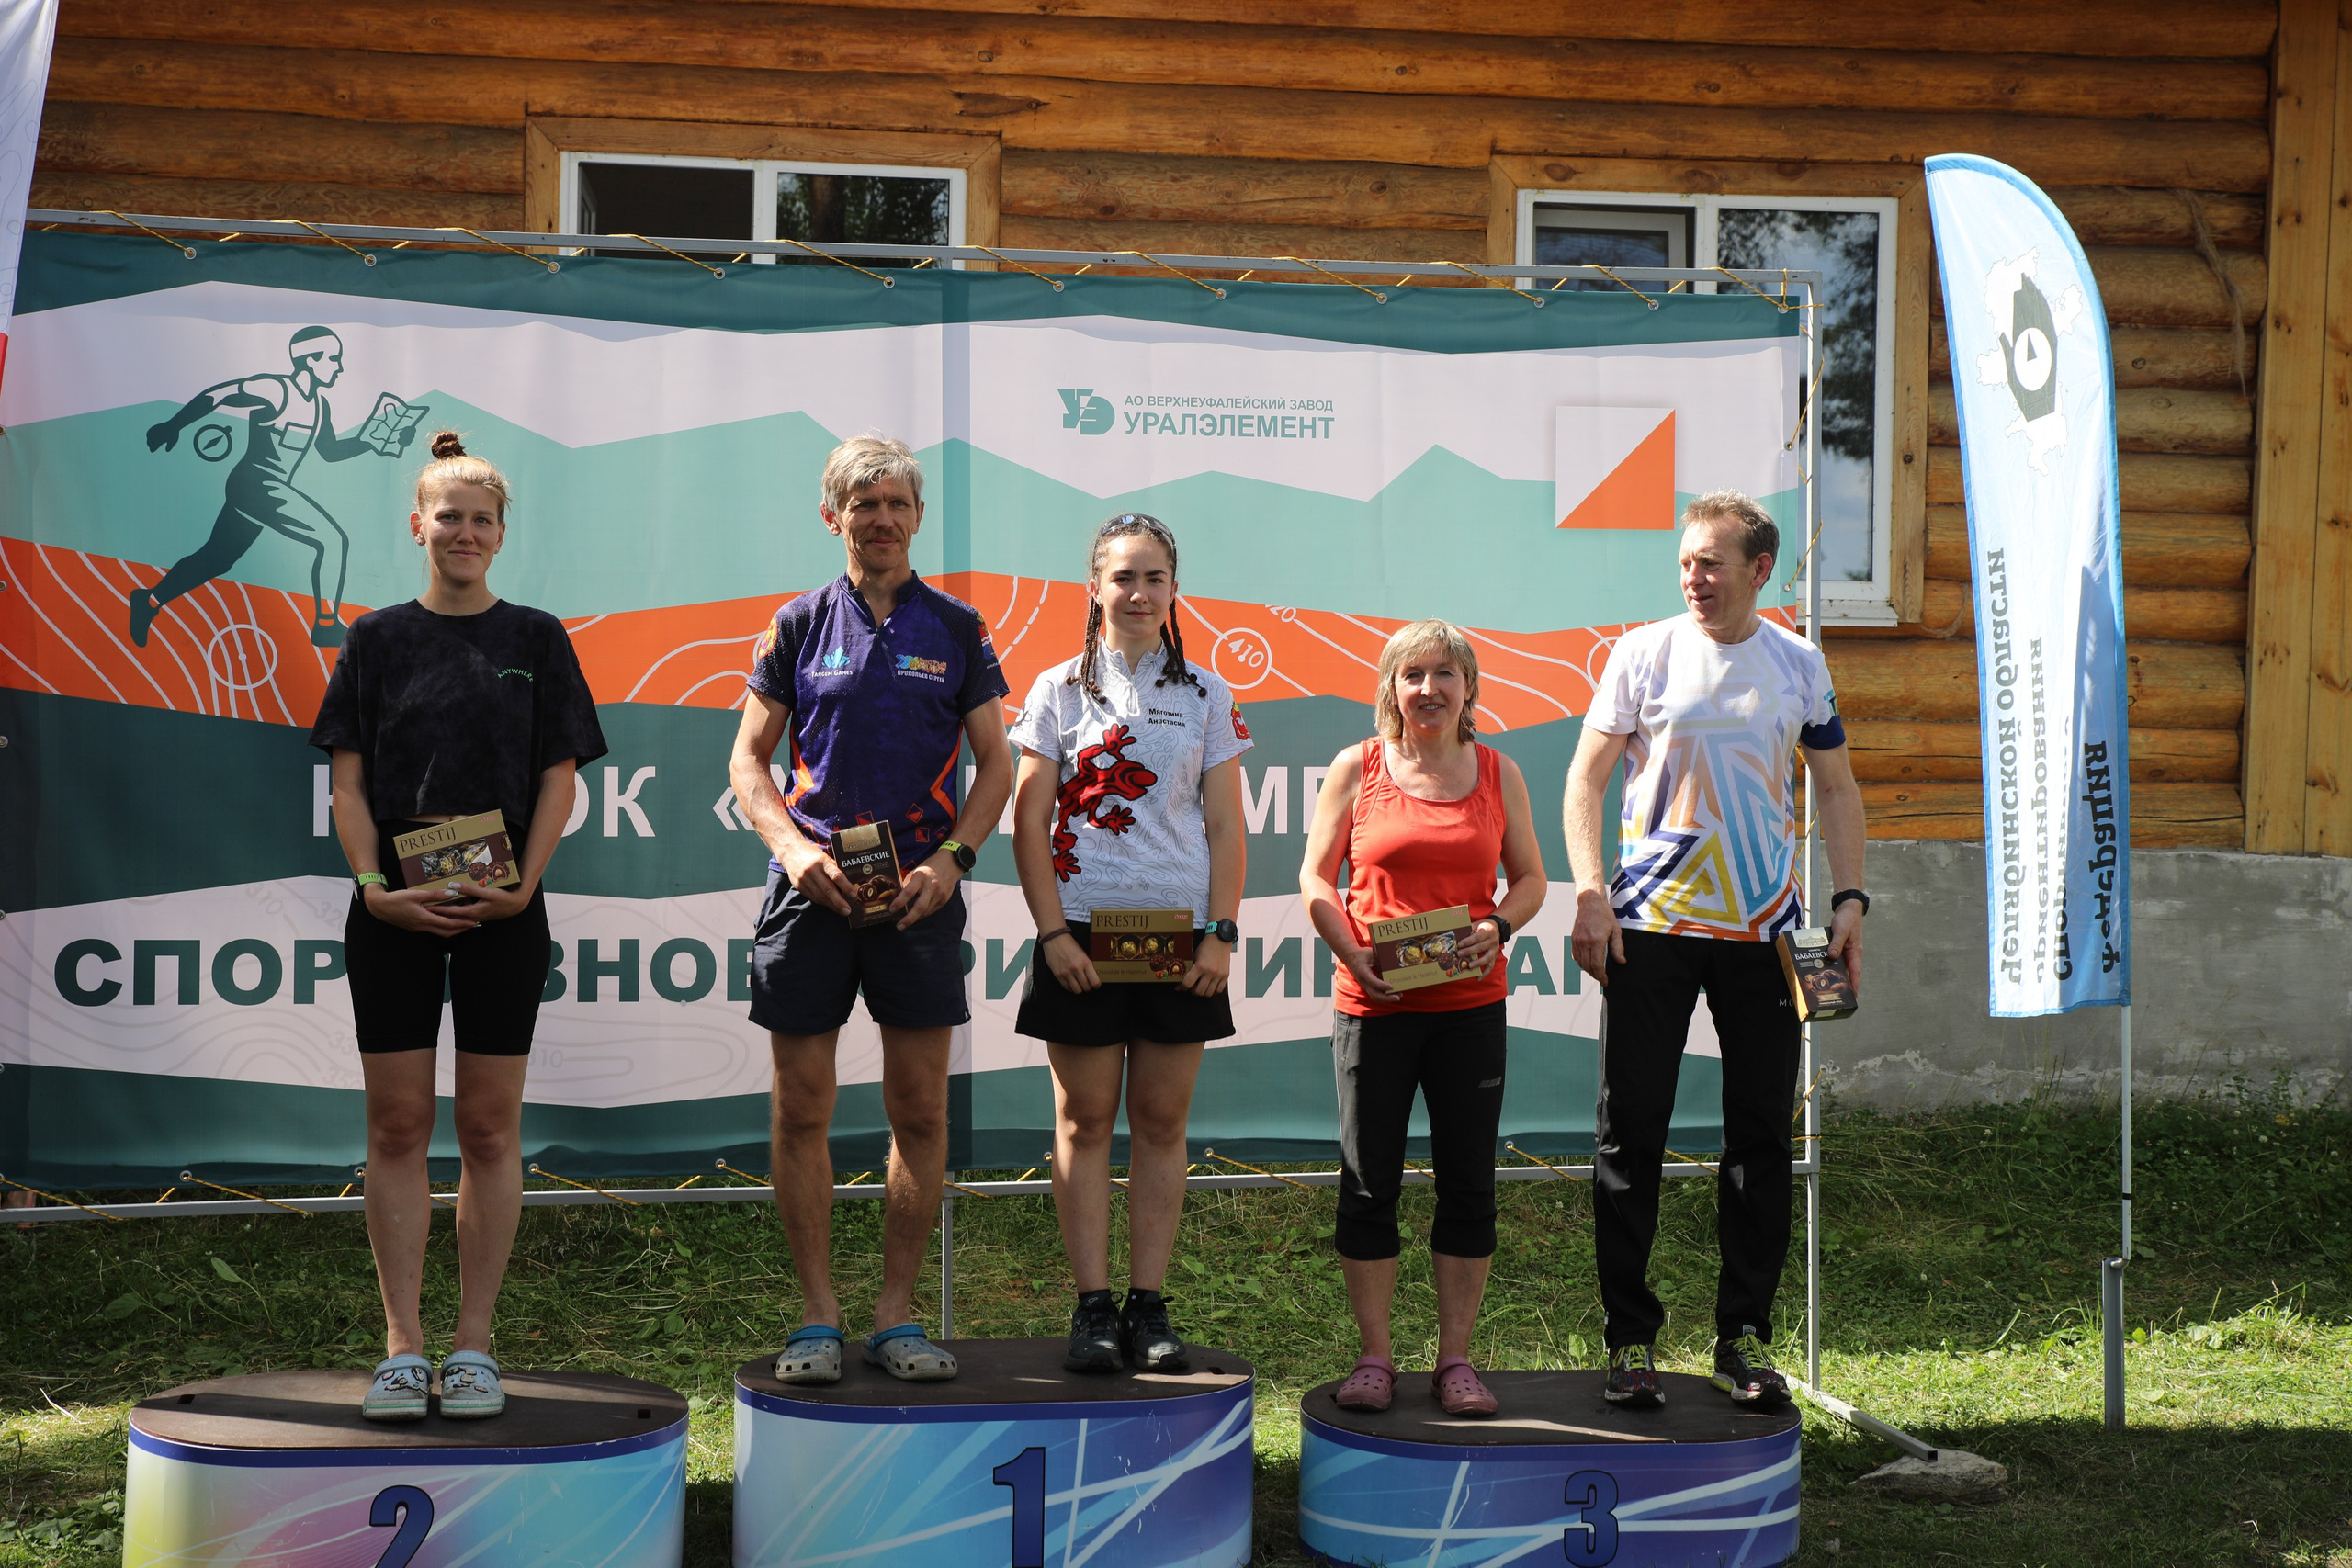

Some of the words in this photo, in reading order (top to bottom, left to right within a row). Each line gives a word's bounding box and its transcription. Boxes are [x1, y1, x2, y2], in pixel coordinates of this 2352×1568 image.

[1124, 395, 1144, 406] АО
[1148, 395, 1286, 410] ВЕРХНЕУФАЛЕЙСКИЙ
[1290, 399, 1333, 412] ЗАВОД
[1123, 412, 1335, 439] УРАЛЭЛЕМЕНТ
[1227, 638, 1264, 668] 410
[497, 668, 534, 682] ANYWHERE
[1148, 708, 1183, 717] Мяготина
[1148, 717, 1186, 728] Анастасия
[399, 826, 458, 852] PRESTIJ
[841, 851, 890, 868] БАБАЕВСКИЕ
[1096, 915, 1148, 930] PRESTIJ
[1377, 917, 1429, 937] PRESTIJ
[992, 1447, 1046, 1568] 1
[368, 1484, 435, 1568] 2
[1564, 1470, 1619, 1567] 3
